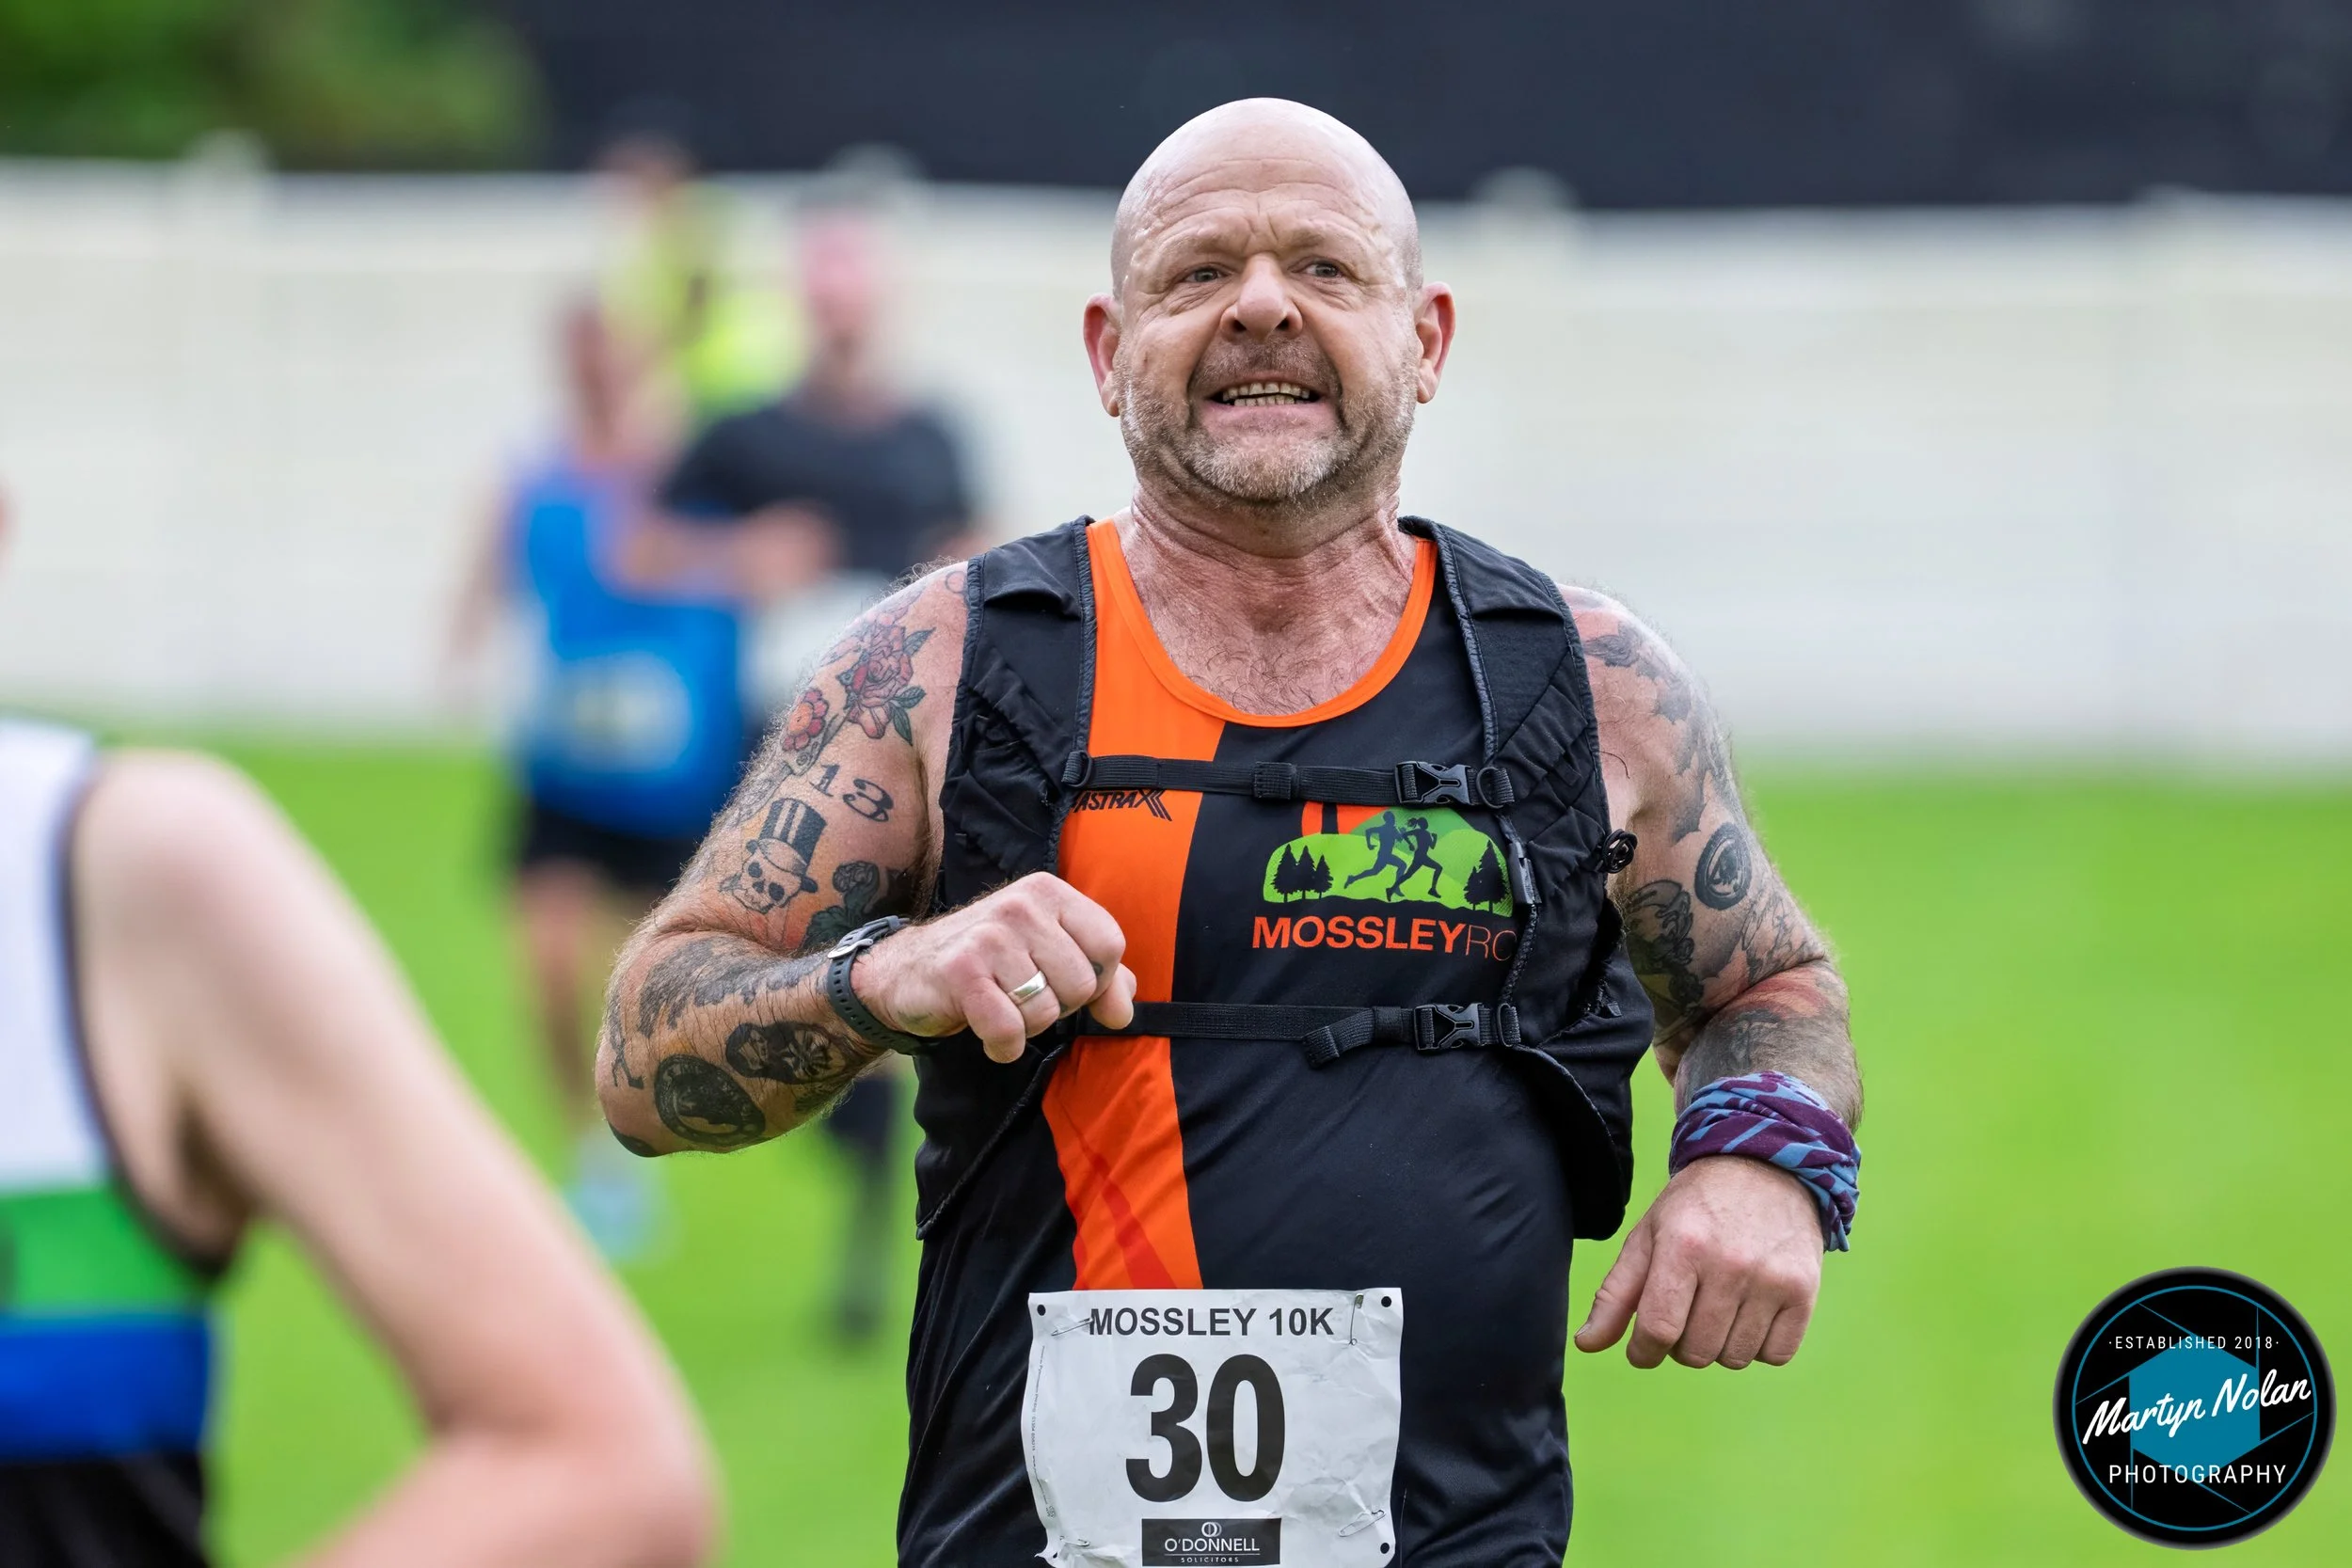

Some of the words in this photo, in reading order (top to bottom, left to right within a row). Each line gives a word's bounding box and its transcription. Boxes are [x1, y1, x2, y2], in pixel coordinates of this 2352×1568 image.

[809, 763, 894, 822] 13
[1072, 789, 1172, 821] ASTRAX
[1089, 1307, 1257, 1336] MOSSLEY
[1269, 1307, 1334, 1336] 10K
[1126, 1354, 1285, 1502] 30
[1164, 1538, 1260, 1552] O'DONNELL
